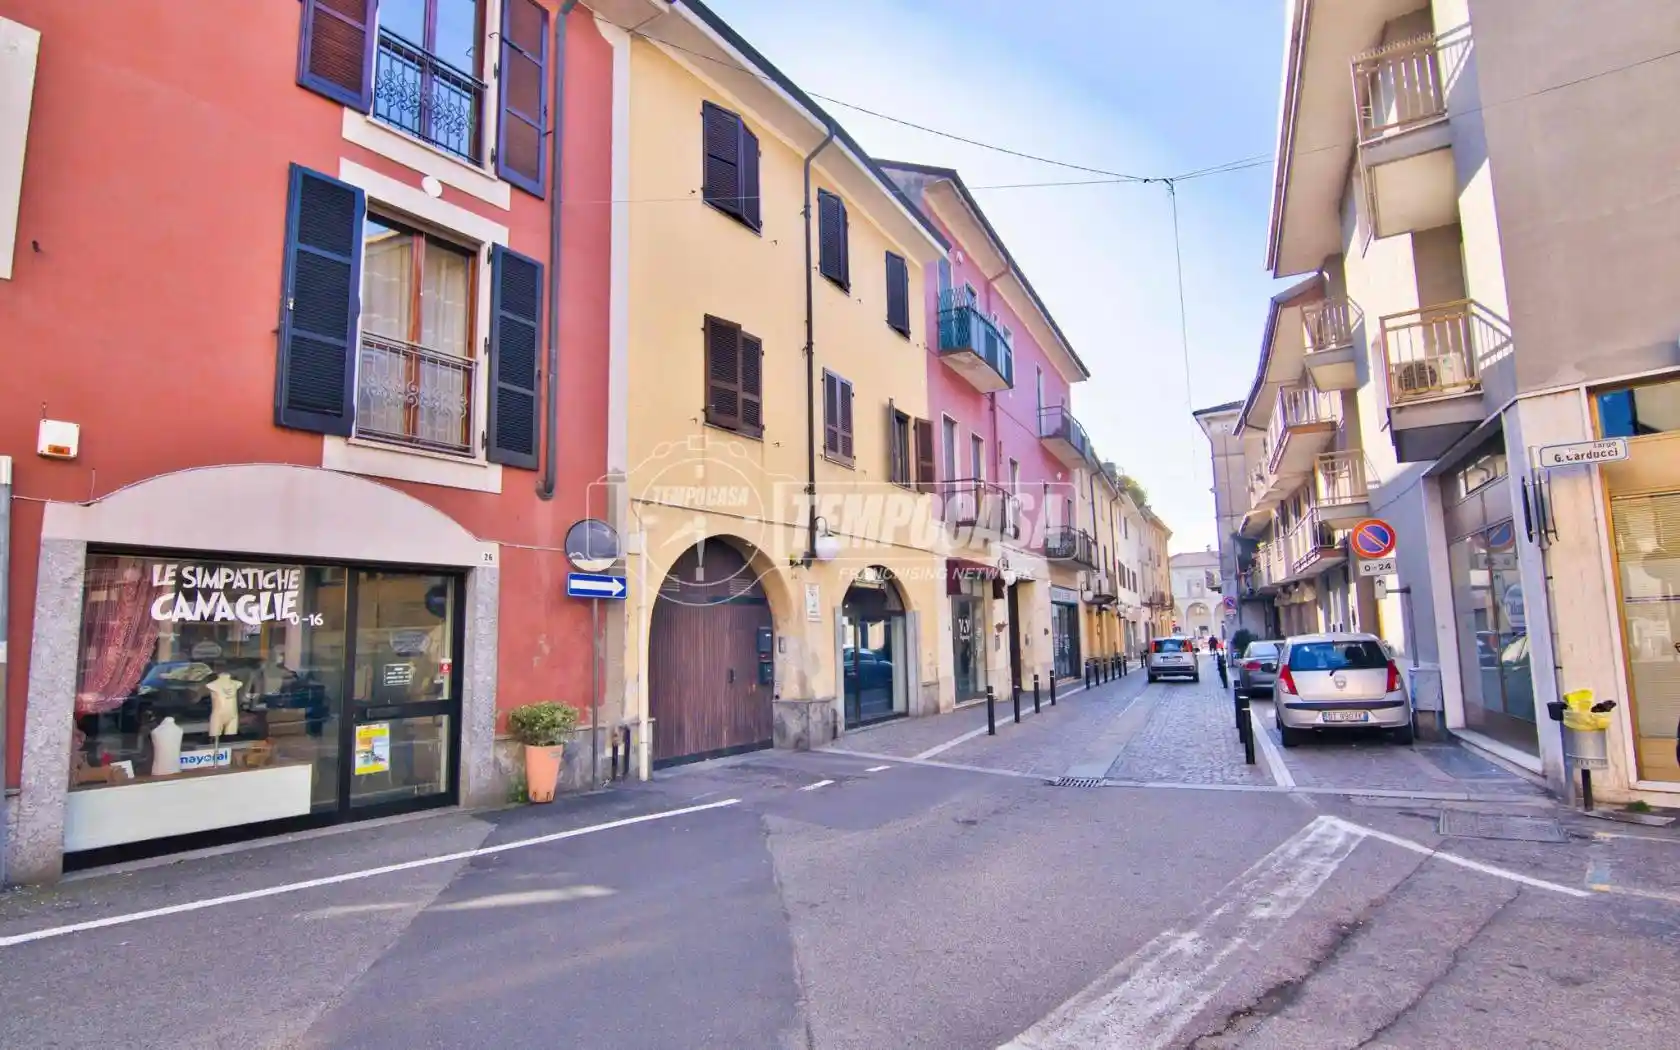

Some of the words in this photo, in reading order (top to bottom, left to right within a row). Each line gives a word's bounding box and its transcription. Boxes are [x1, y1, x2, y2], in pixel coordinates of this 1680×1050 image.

[1554, 453, 1564, 463] G.
[484, 552, 493, 561] 26
[152, 564, 179, 588] LE
[181, 565, 301, 591] SIMPATICHE
[151, 590, 299, 625] CANAGLIE
